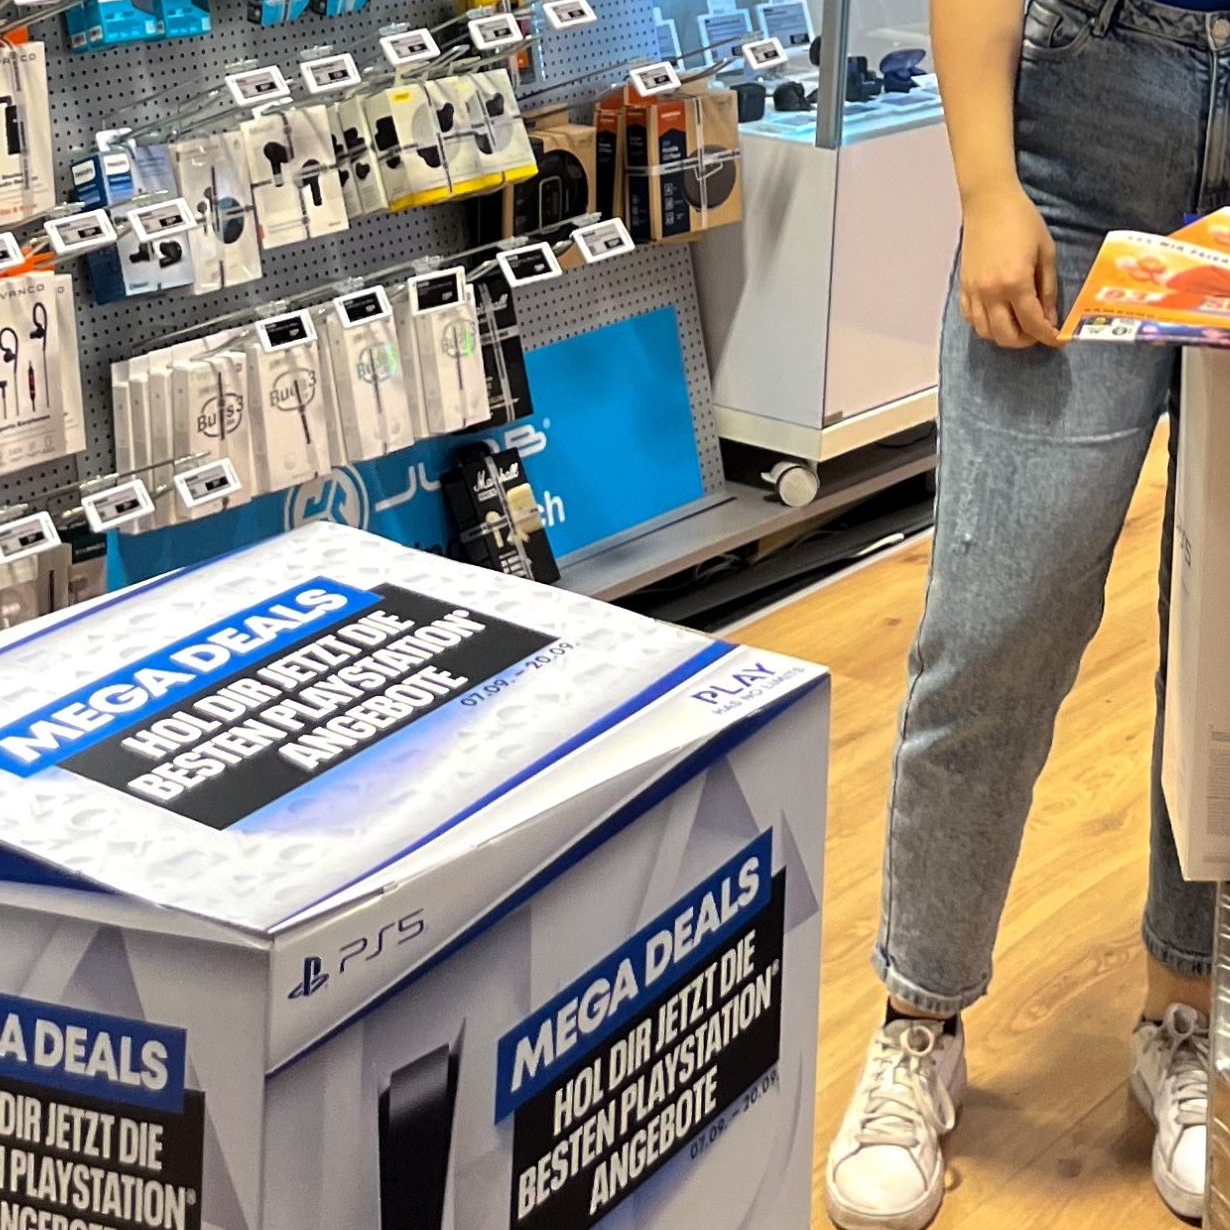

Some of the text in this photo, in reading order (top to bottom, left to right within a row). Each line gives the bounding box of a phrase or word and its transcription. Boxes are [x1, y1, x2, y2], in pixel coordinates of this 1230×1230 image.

[1, 587, 349, 766] MEGA DEALS
[121, 609, 415, 760] HOL DIR JETZT DIE
[278, 665, 470, 774] ANGEBOTE
[689, 662, 776, 705] PLAY
[127, 717, 288, 804] BESTEN
[339, 907, 425, 974] PS5
[511, 856, 760, 1093] MEGA DEALS
[33, 1018, 168, 1091] DEALS
[553, 929, 756, 1136] HOL DIR JETZT DIE
[45, 1102, 116, 1159] JETZT
[118, 1117, 164, 1171] DIE
[517, 1099, 617, 1220] BESTEN
[589, 1065, 718, 1217] ANGEBOTE
